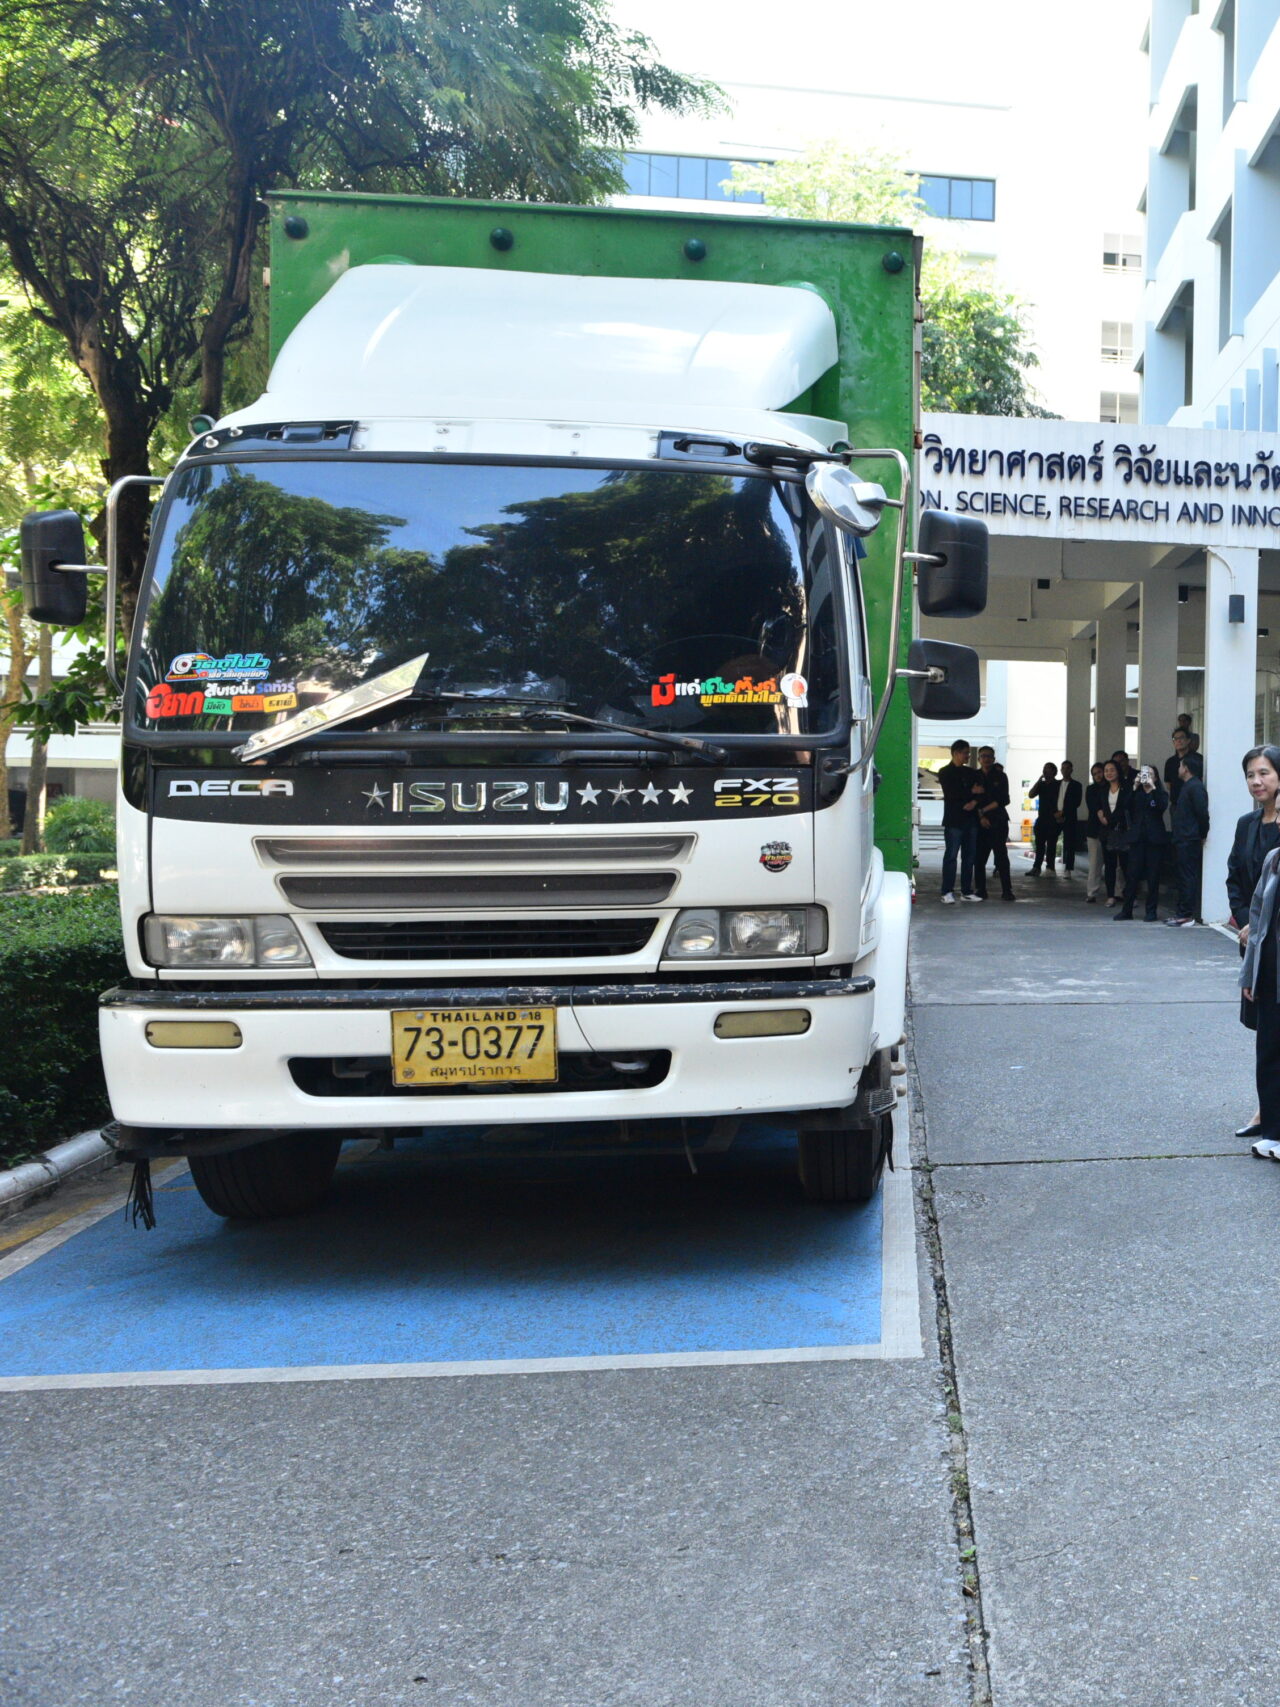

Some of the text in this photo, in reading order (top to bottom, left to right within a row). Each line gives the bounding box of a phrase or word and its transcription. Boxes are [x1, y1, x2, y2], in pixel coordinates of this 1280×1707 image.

[923, 433, 1105, 482] วิทยาศาสตร์
[955, 490, 1051, 519] SCIENCE,
[1059, 496, 1170, 522] RESEARCH
[1176, 501, 1224, 525] AND
[146, 683, 205, 719] อยาก
[168, 779, 294, 797] DECA
[392, 781, 569, 812] ISUZU
[714, 777, 799, 792] FXZ
[714, 793, 800, 807] 270
[430, 1011, 517, 1022] THAILAND
[403, 1024, 545, 1062] 73-0377
[430, 1065, 522, 1080] สมุทรปราการ
